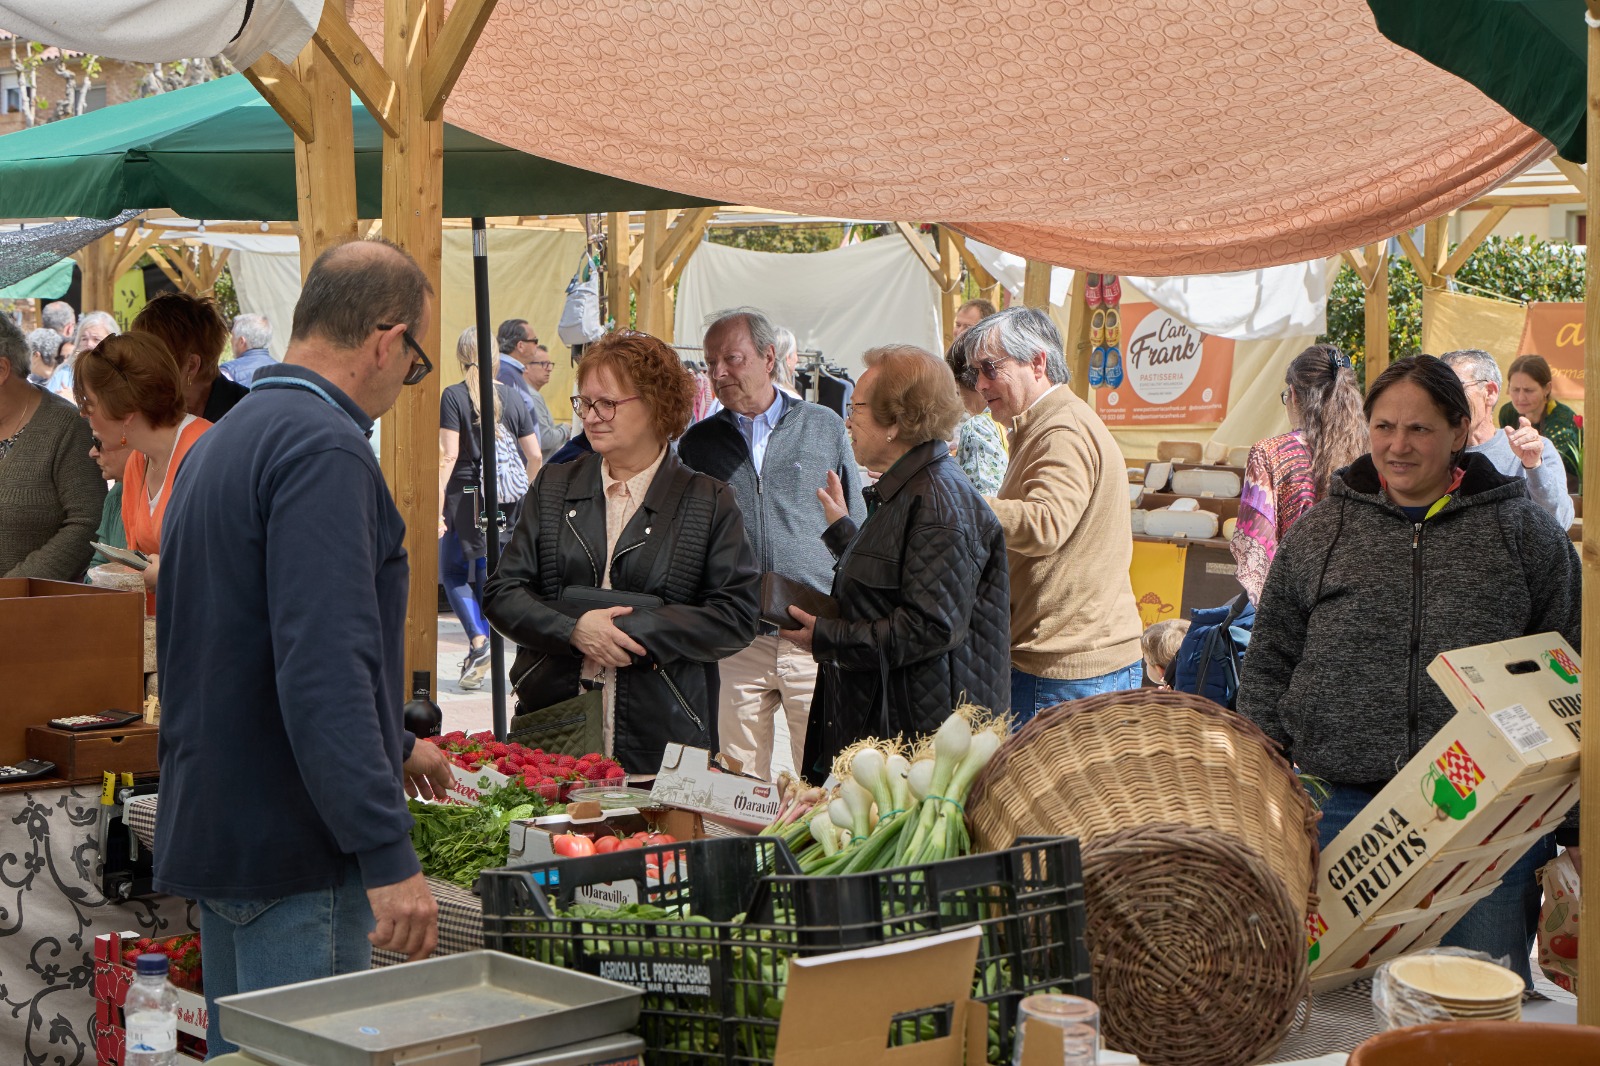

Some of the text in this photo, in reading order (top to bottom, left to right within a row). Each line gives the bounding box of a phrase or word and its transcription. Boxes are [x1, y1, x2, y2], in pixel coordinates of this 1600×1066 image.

[1158, 317, 1188, 343] Can
[1129, 330, 1201, 370] Frank
[1139, 373, 1184, 382] PASTISSERIA
[1327, 807, 1410, 891] GIRONA
[1341, 828, 1427, 918] FRUITS
[581, 884, 628, 904] Maravilla
[600, 961, 638, 980] AGRICOLA
[639, 962, 651, 982] EL
[647, 983, 663, 993] MAR
[664, 984, 675, 995] (EL
[676, 985, 711, 997] MARESME)
[183, 1010, 194, 1024] del
